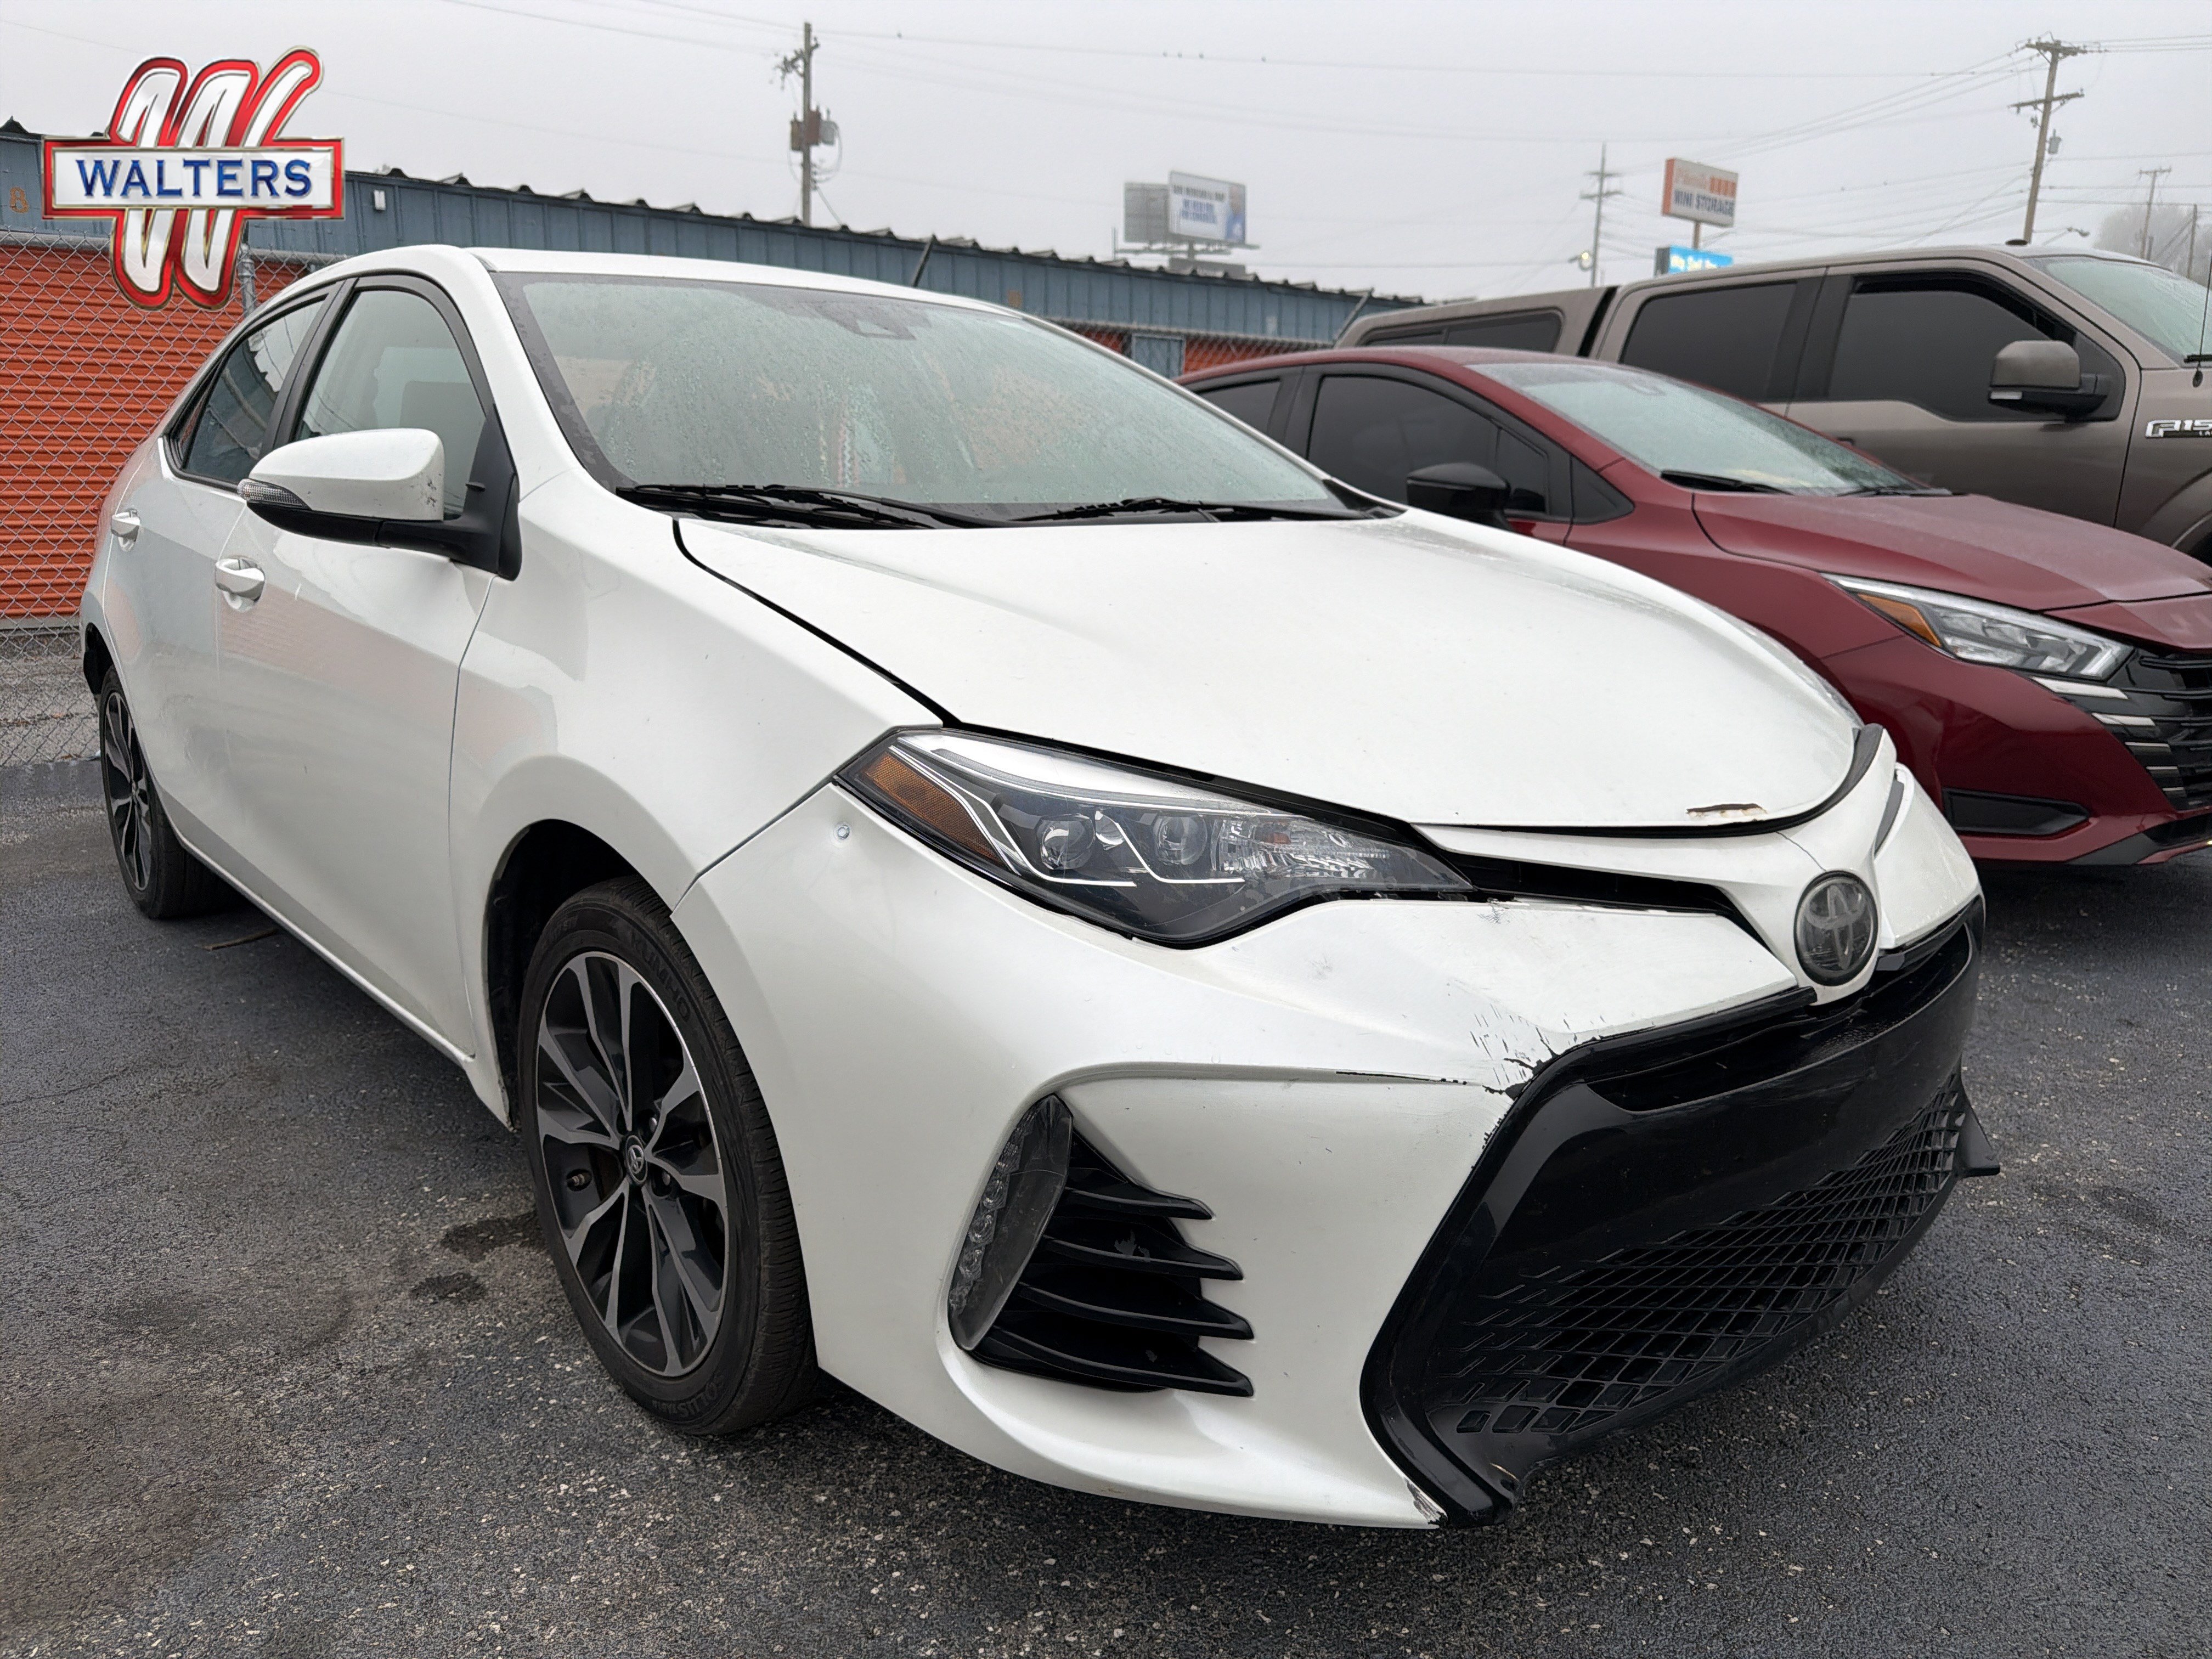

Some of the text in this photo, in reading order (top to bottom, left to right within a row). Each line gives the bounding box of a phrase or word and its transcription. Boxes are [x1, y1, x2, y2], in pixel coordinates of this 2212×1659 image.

[9, 186, 29, 213] 8
[1674, 190, 1734, 217] MINI STORAGE
